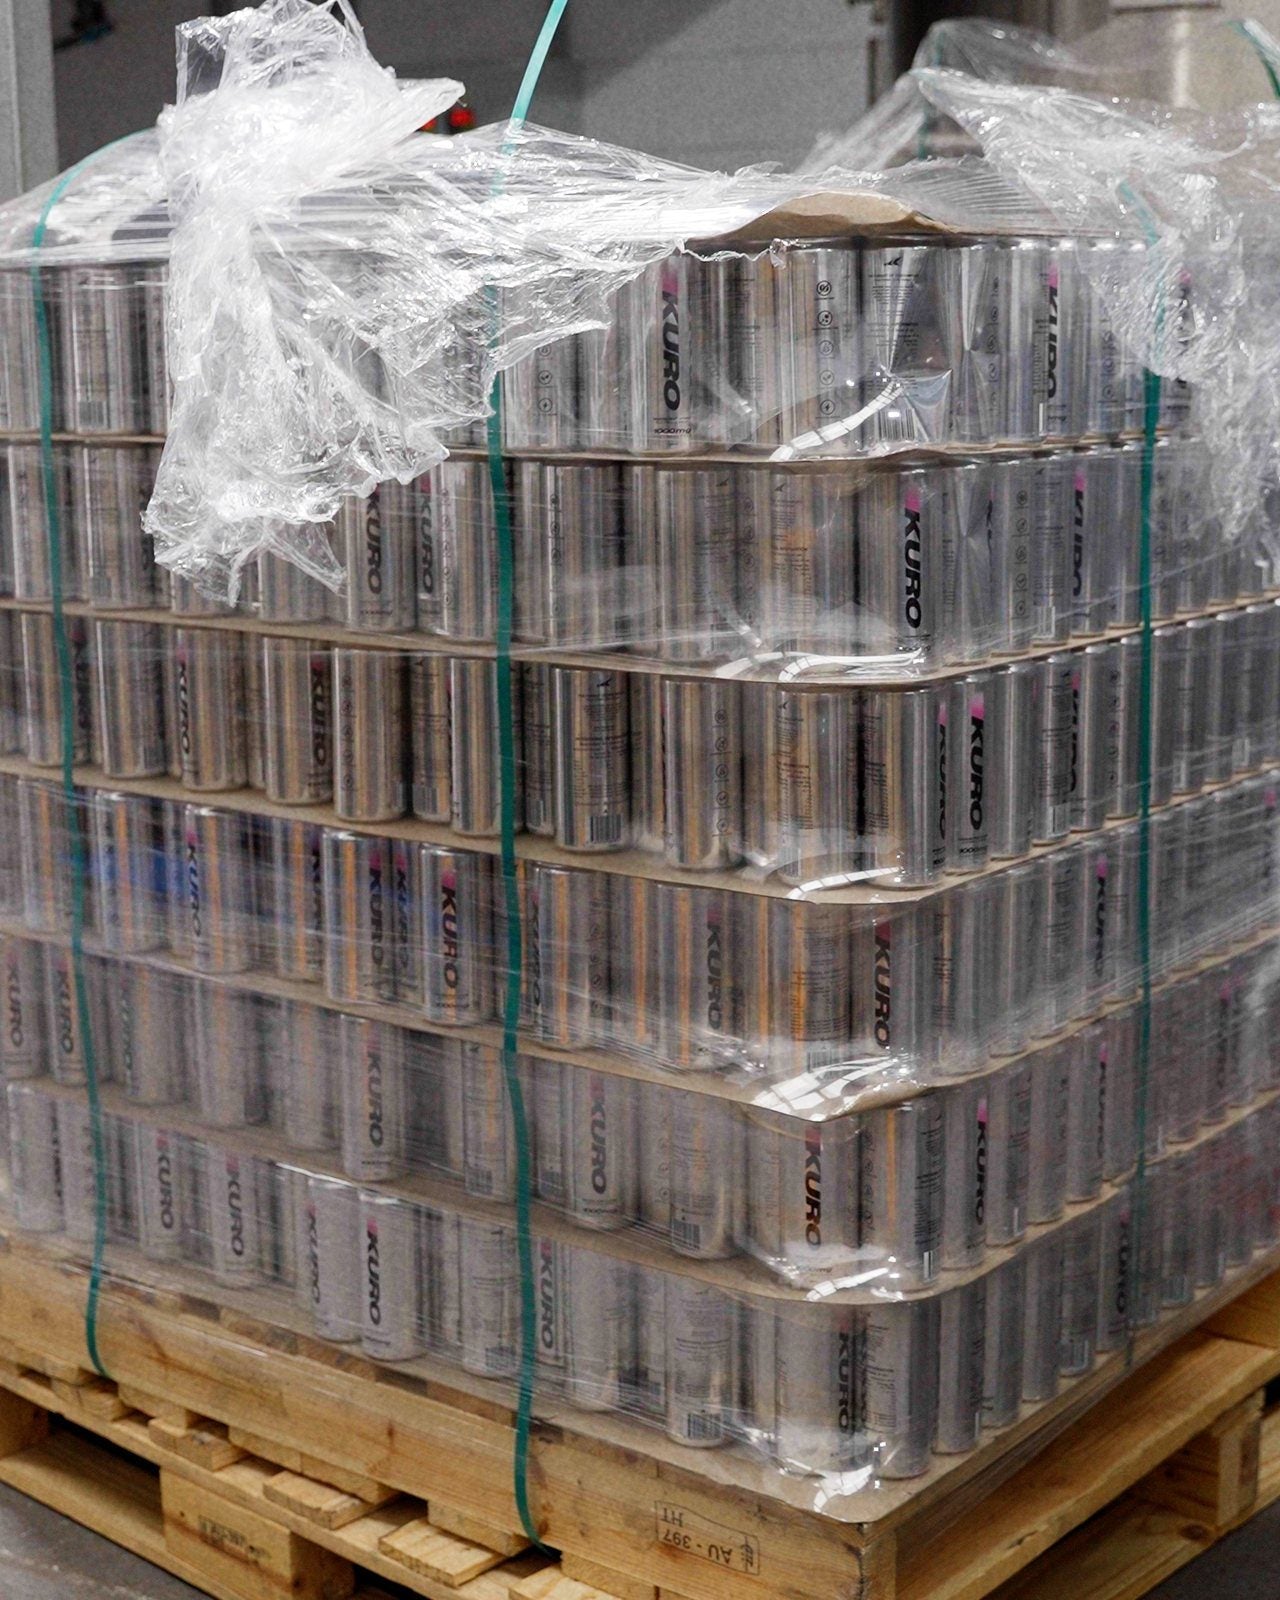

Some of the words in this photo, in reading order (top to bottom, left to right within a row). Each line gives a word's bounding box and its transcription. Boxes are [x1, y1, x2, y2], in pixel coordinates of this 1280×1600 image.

[662, 290, 681, 411] KURO
[420, 493, 433, 594] KURO
[904, 507, 922, 629] KURO
[970, 716, 985, 830] KURO
[442, 885, 458, 989] KURO
[707, 923, 722, 1030] KURO
[874, 934, 891, 1049] KURO
[368, 1051, 384, 1148] KURO
[591, 1096, 607, 1195] KURO
[805, 1140, 821, 1251] KURO
[367, 1230, 381, 1326] KURO
[540, 1252, 554, 1350] KURO
[660, 1507, 684, 1528] HT
[663, 1528, 692, 1550] 397
[708, 1543, 733, 1565] AU
